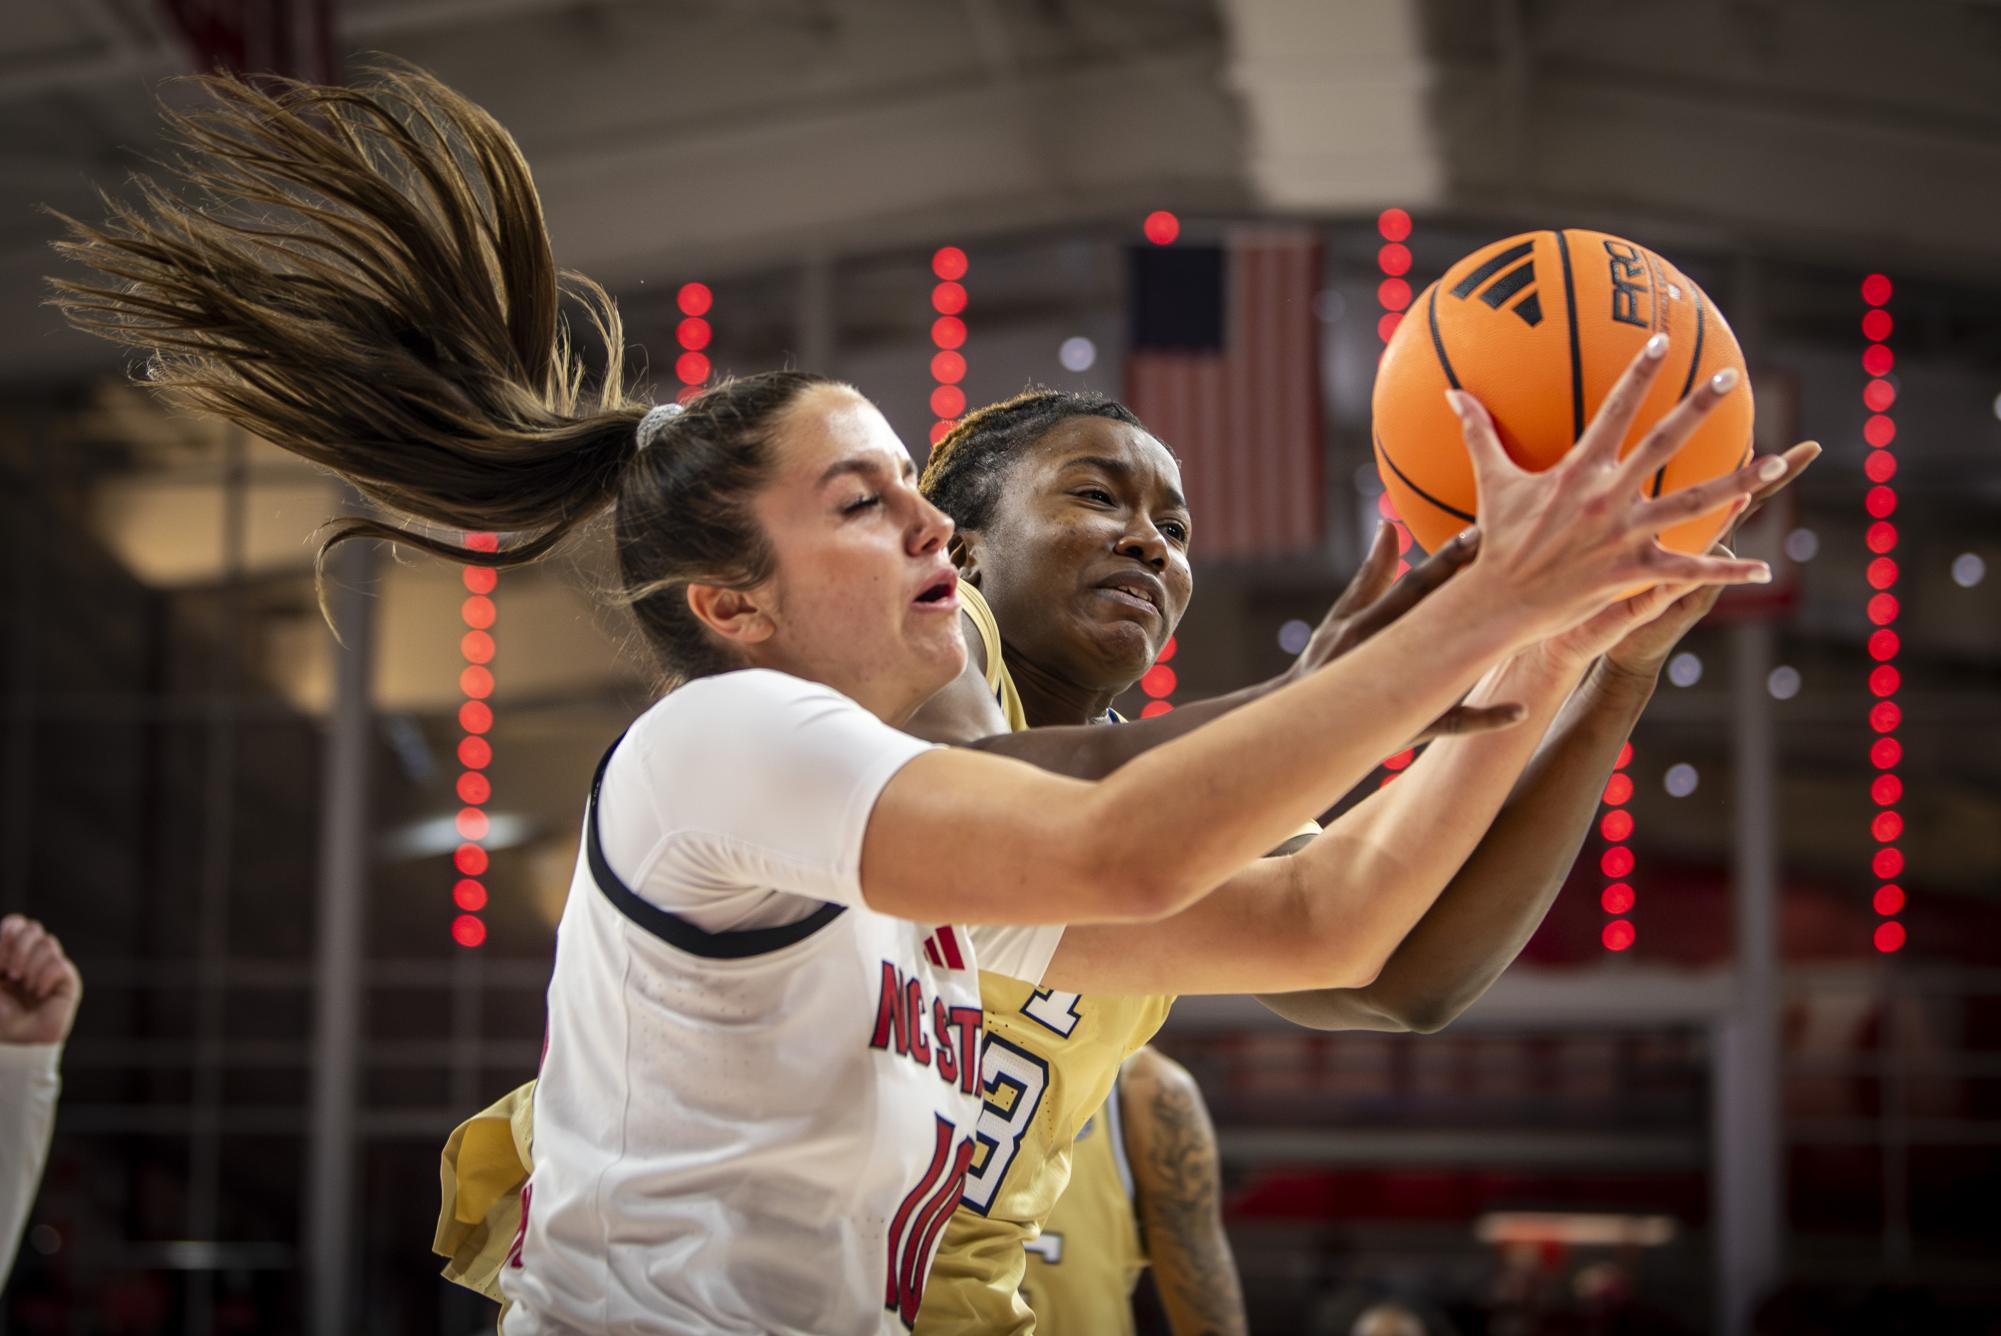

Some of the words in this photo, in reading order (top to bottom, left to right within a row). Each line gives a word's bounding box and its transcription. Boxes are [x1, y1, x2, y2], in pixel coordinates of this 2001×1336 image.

[1603, 240, 1648, 329] PRO
[869, 959, 931, 1068] NC
[933, 995, 983, 1099] ST
[959, 1030, 1050, 1218] 3
[884, 1110, 976, 1332] 10
